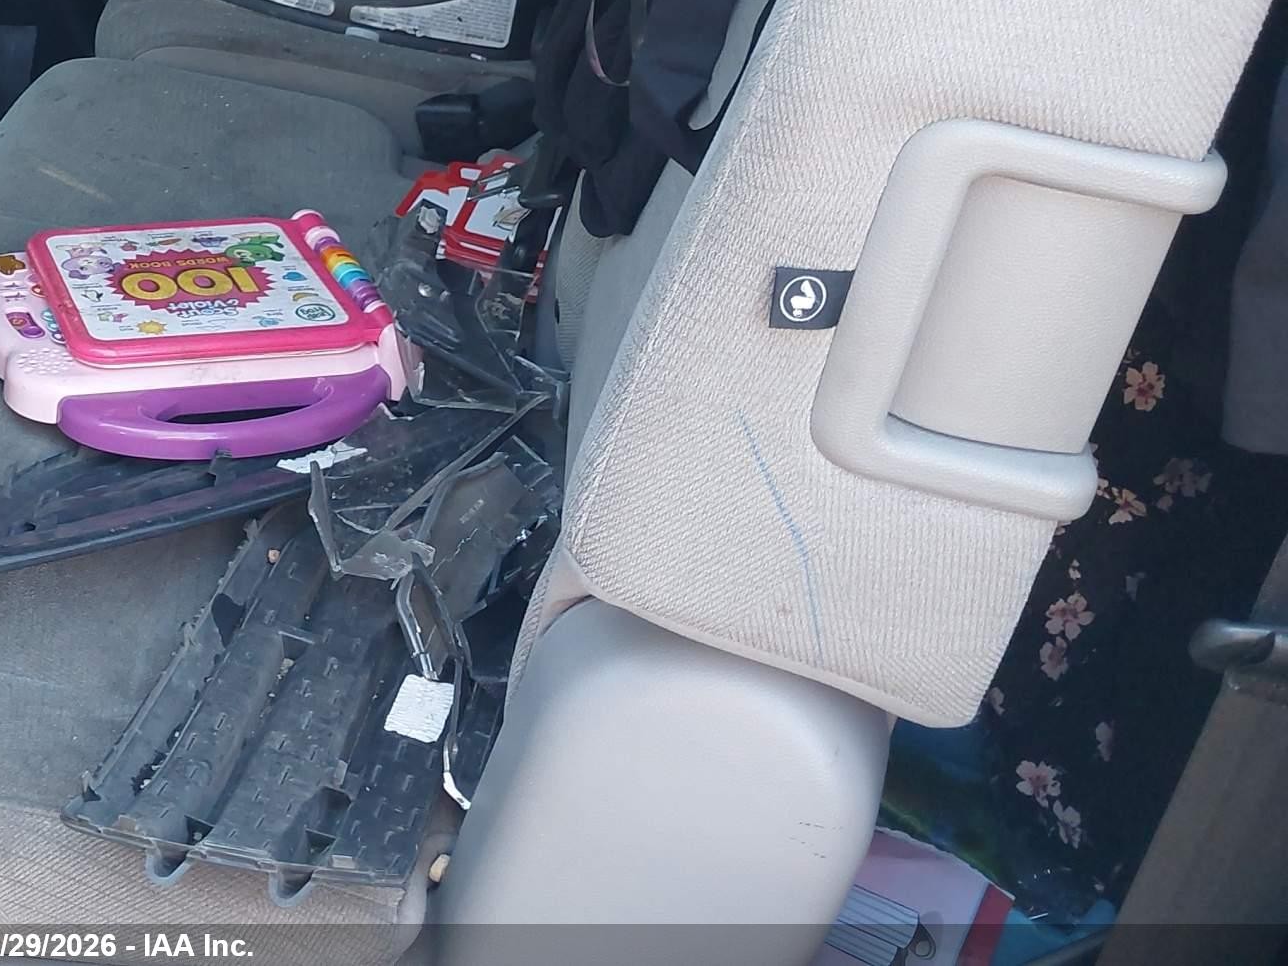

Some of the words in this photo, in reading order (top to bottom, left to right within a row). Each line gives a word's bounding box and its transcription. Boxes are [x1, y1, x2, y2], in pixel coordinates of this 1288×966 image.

[128, 260, 172, 269] BOOK
[174, 256, 230, 266] WORDS
[120, 265, 261, 301] 100
[177, 306, 239, 320] Scout
